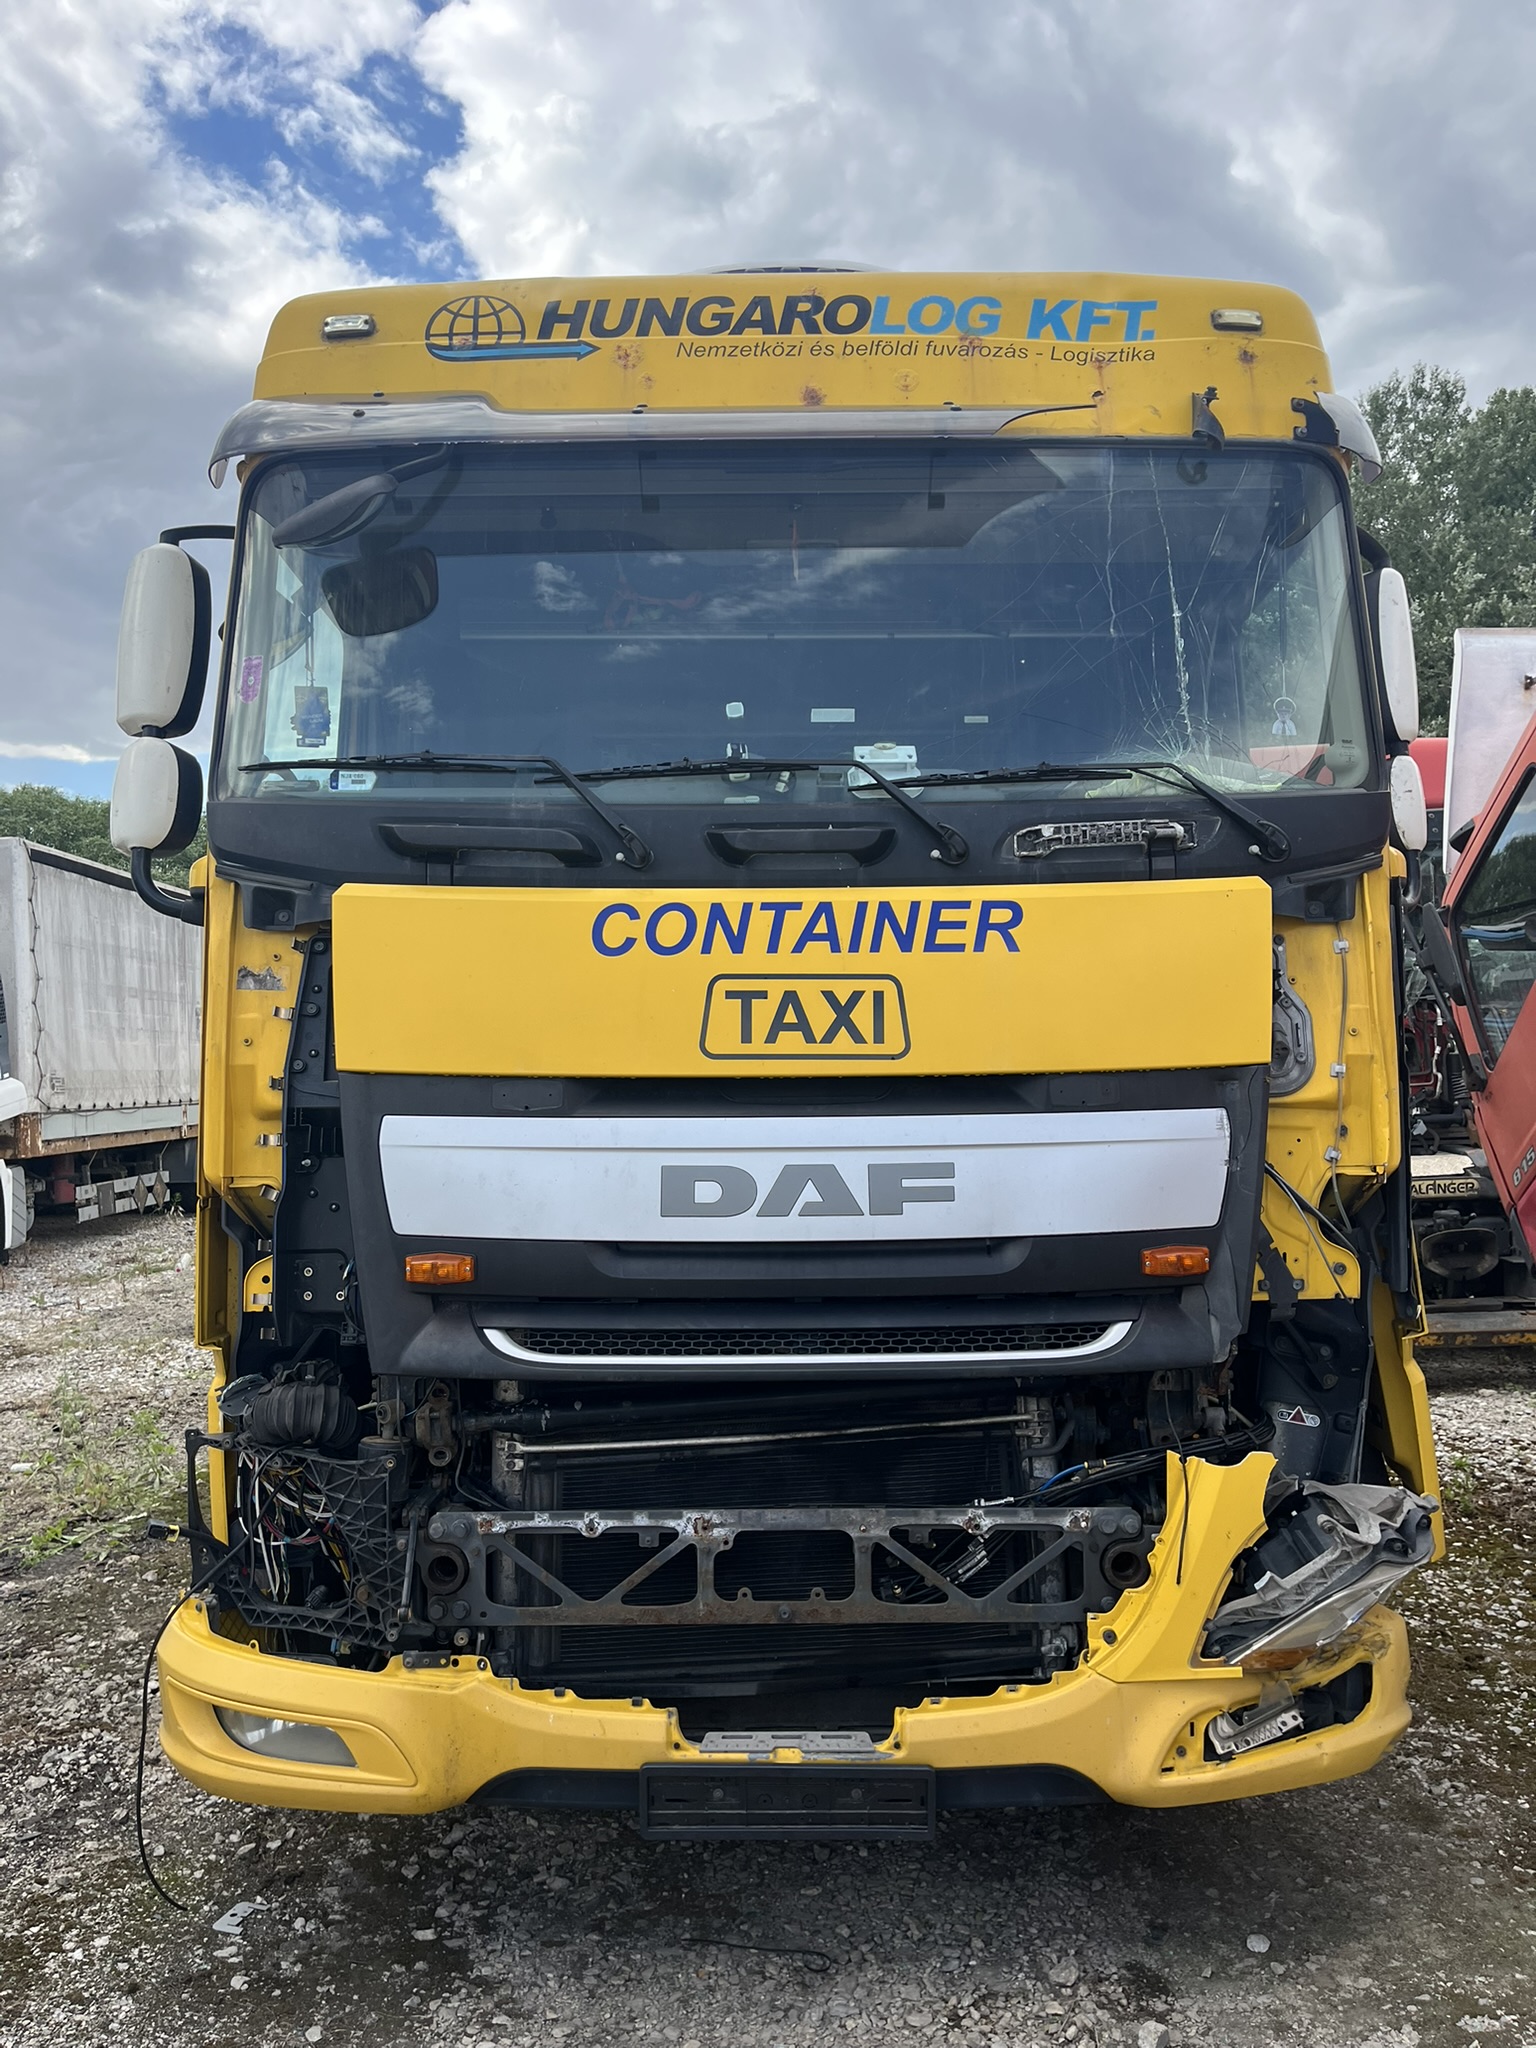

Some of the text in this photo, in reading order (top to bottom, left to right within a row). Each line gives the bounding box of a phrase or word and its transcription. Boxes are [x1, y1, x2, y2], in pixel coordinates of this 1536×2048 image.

[536, 294, 1158, 342] HUNGAROLOG KFT.
[676, 340, 804, 358] Nemzetközi
[809, 340, 835, 357] és
[841, 339, 919, 357] belföldi
[925, 340, 1029, 359] fuvarozás
[1050, 345, 1156, 366] Logisztika
[591, 899, 1024, 957] CONTAINER
[724, 989, 885, 1045] TAXI
[660, 1161, 956, 1218] DAF
